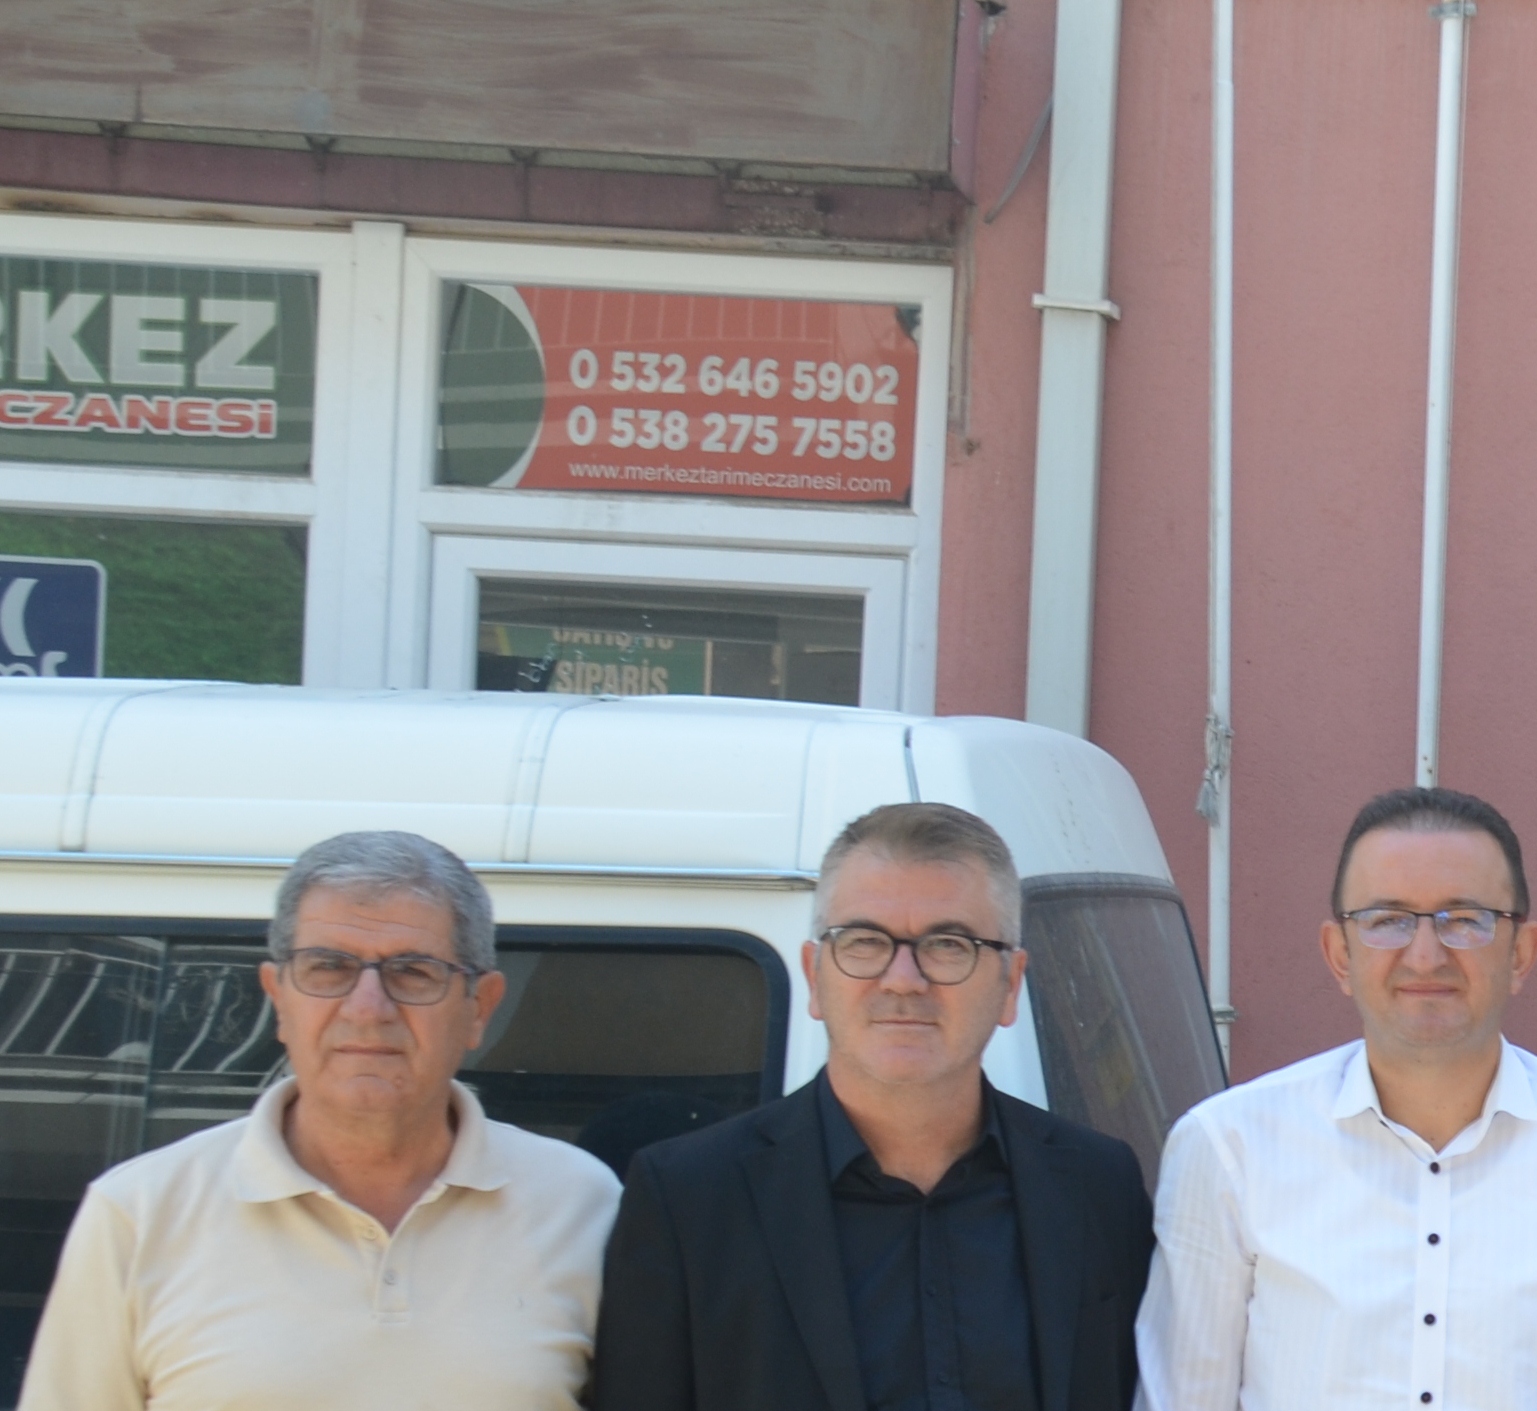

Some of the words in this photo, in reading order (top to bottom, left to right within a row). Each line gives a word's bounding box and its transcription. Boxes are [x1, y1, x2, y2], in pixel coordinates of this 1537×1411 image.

[0, 288, 277, 390] KEZ
[569, 349, 599, 389] 0
[609, 351, 687, 394] 532
[698, 355, 781, 399] 646
[791, 360, 899, 405] 5902
[566, 405, 597, 446] 0
[608, 407, 689, 450] 538
[701, 413, 779, 456] 275
[791, 417, 897, 462] 7558
[568, 461, 892, 493] www.merkeztarimeczanesi.com
